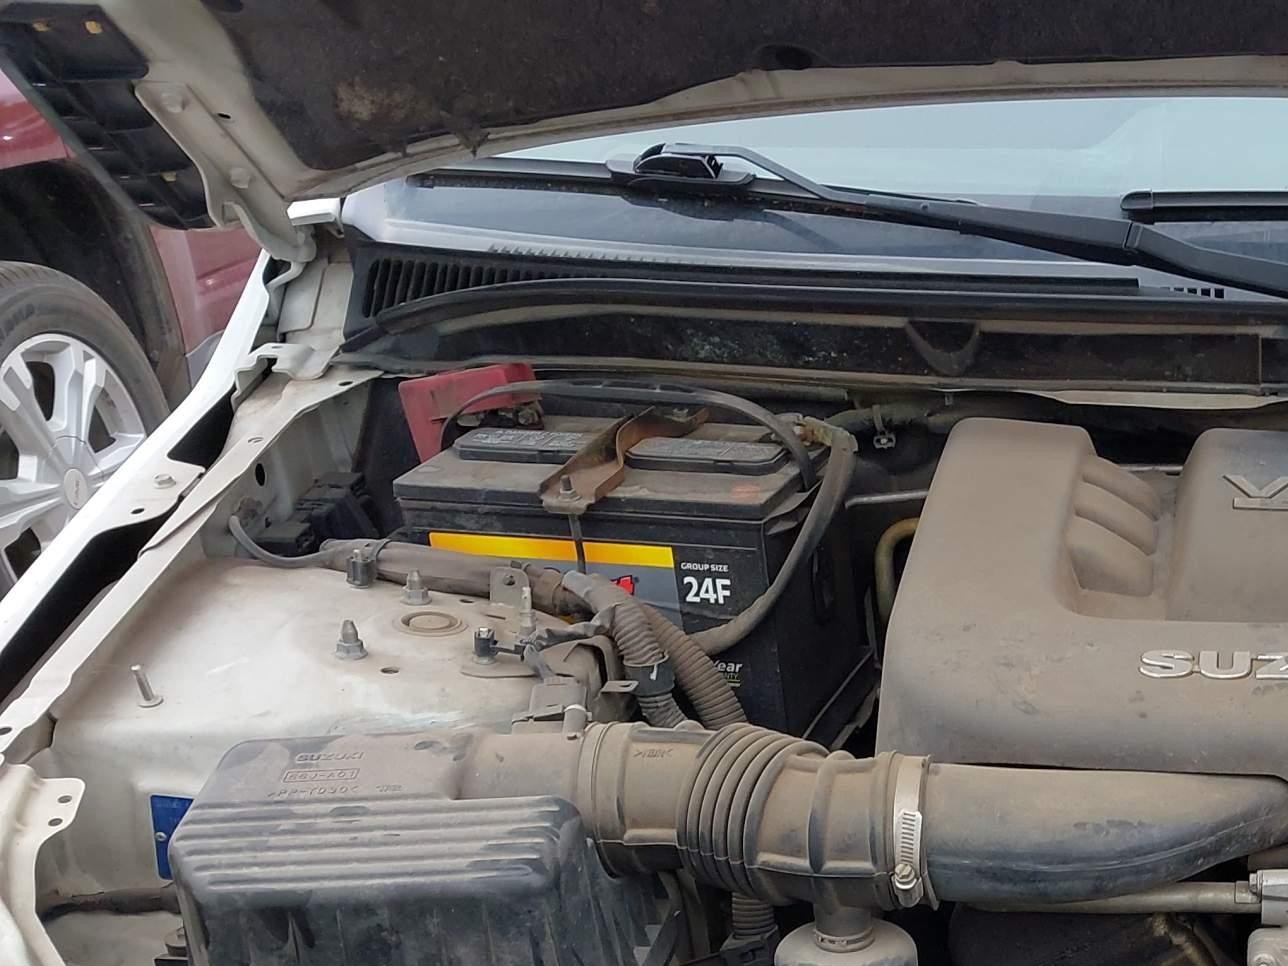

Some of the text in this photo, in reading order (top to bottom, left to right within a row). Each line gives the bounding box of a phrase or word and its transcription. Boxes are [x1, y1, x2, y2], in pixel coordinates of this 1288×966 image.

[680, 562, 729, 572] GROUP SIZE
[683, 576, 731, 604] 24F
[295, 751, 365, 763] SUZUKI
